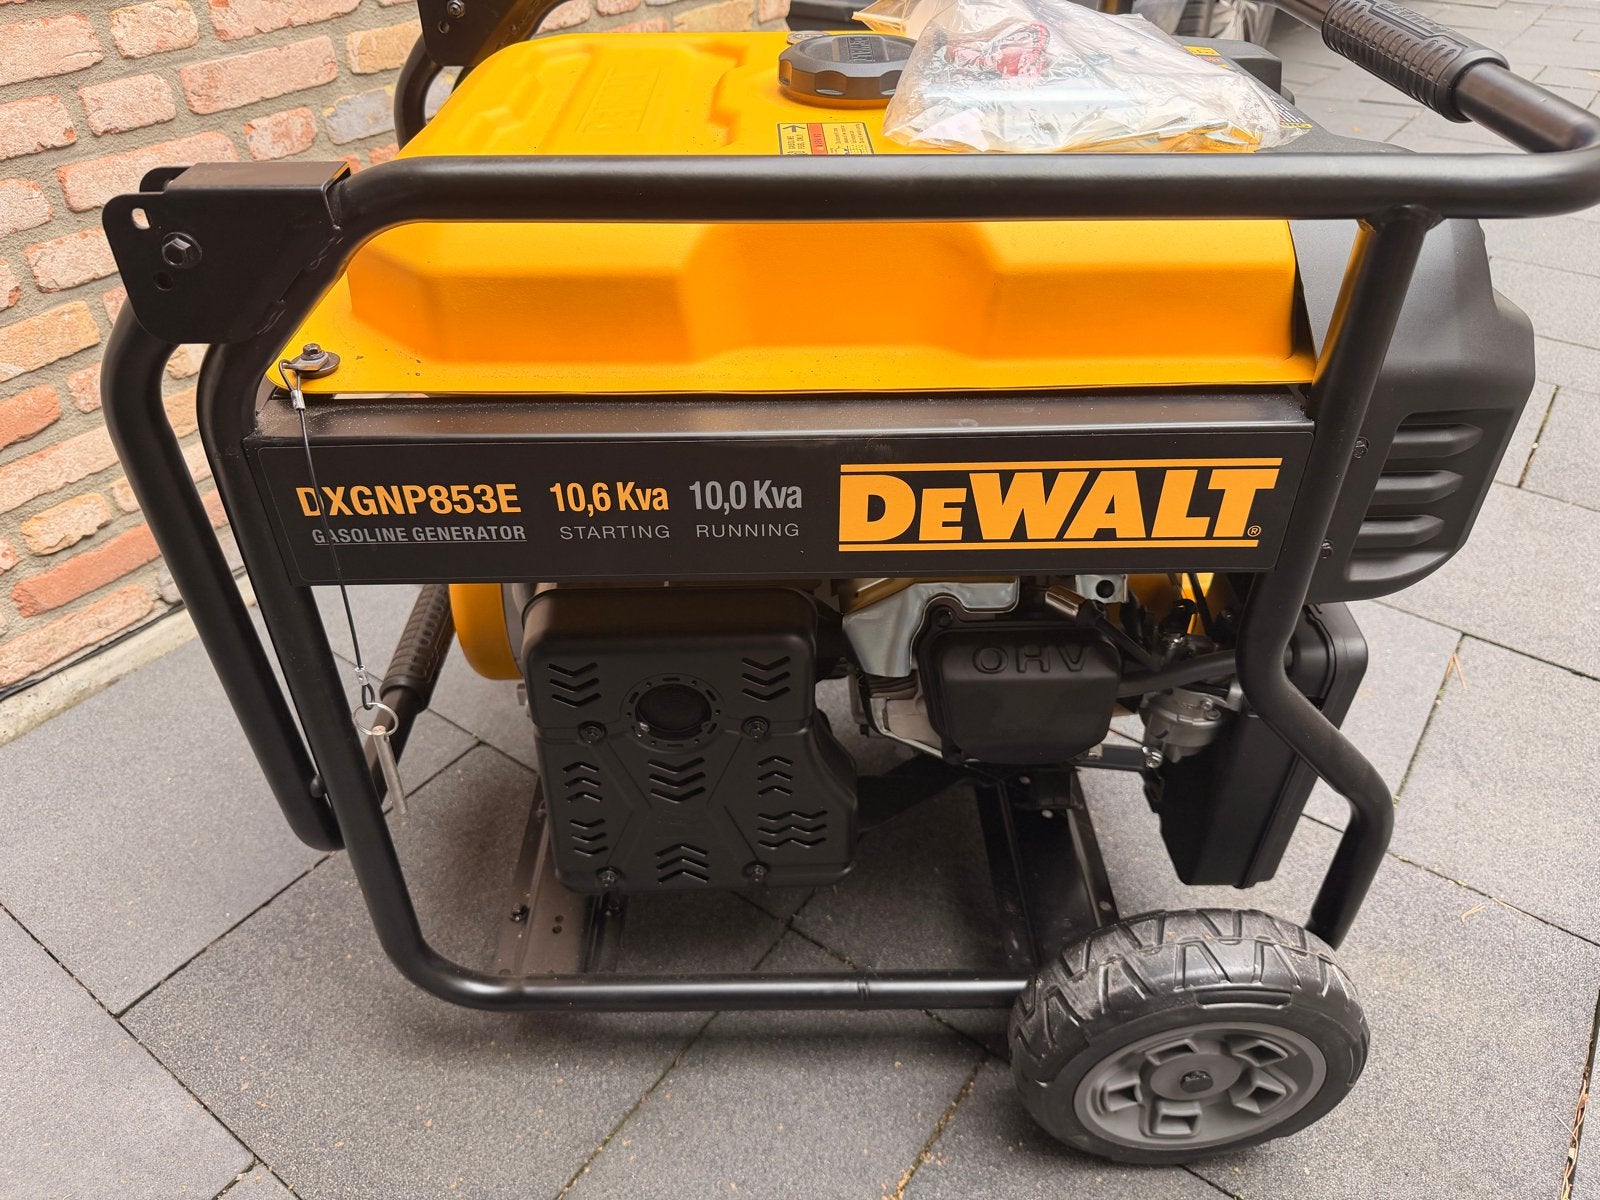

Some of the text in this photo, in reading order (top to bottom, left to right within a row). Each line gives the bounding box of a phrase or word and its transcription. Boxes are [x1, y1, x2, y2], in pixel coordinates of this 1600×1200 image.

[296, 483, 522, 516] DXGNP853E
[550, 482, 612, 517] 10,6
[616, 481, 669, 511] Kva
[689, 480, 747, 515] 10,0
[753, 479, 802, 509] Kva
[312, 523, 799, 544] GASOLINE GENERATOR STARTING RUNNING
[972, 646, 1089, 674] OHV
